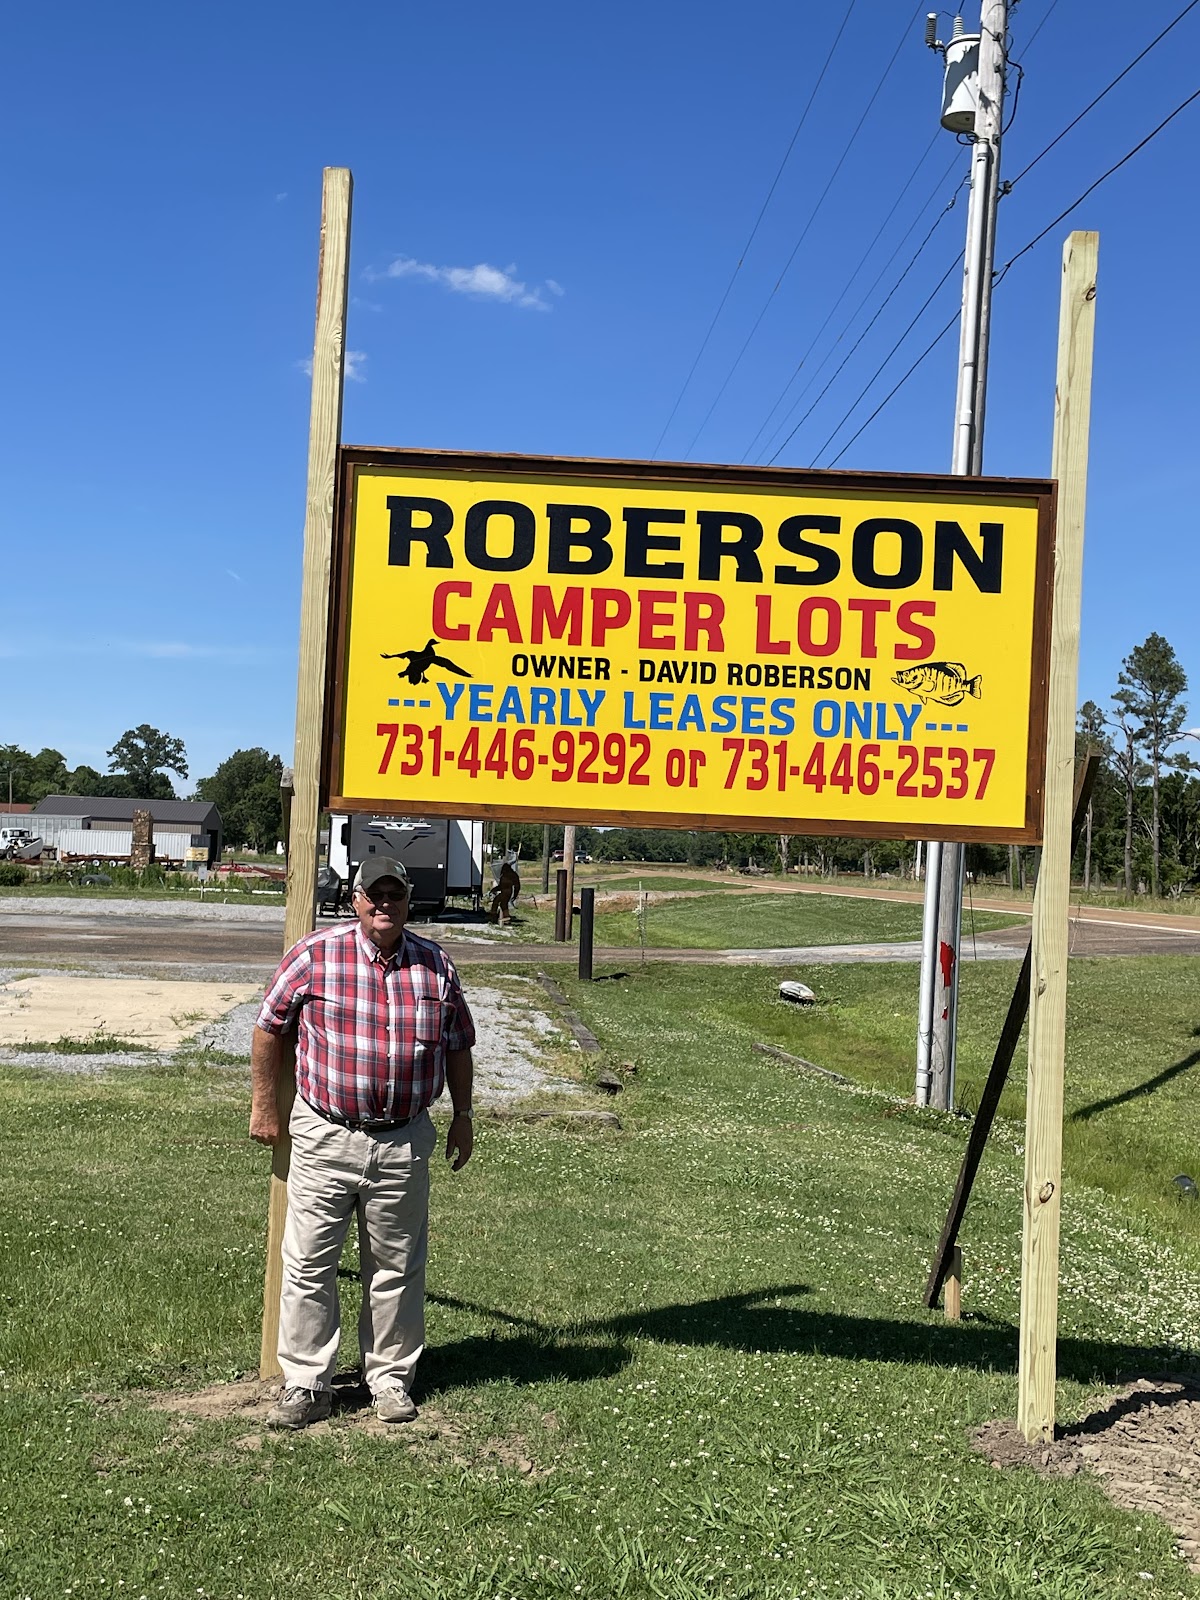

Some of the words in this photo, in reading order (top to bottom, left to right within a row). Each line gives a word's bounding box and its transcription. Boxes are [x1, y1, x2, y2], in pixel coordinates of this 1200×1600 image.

[386, 495, 1004, 594] ROBERSON
[432, 580, 725, 655] CAMPER
[755, 594, 936, 661] LOTS
[511, 653, 611, 681] OWNER
[639, 659, 717, 686] DAVID
[727, 663, 871, 691] ROBERSON
[624, 691, 795, 735] LEASES
[376, 723, 651, 787] 731-446-9292
[665, 748, 707, 788] or
[722, 737, 996, 800] 731-446-2537
